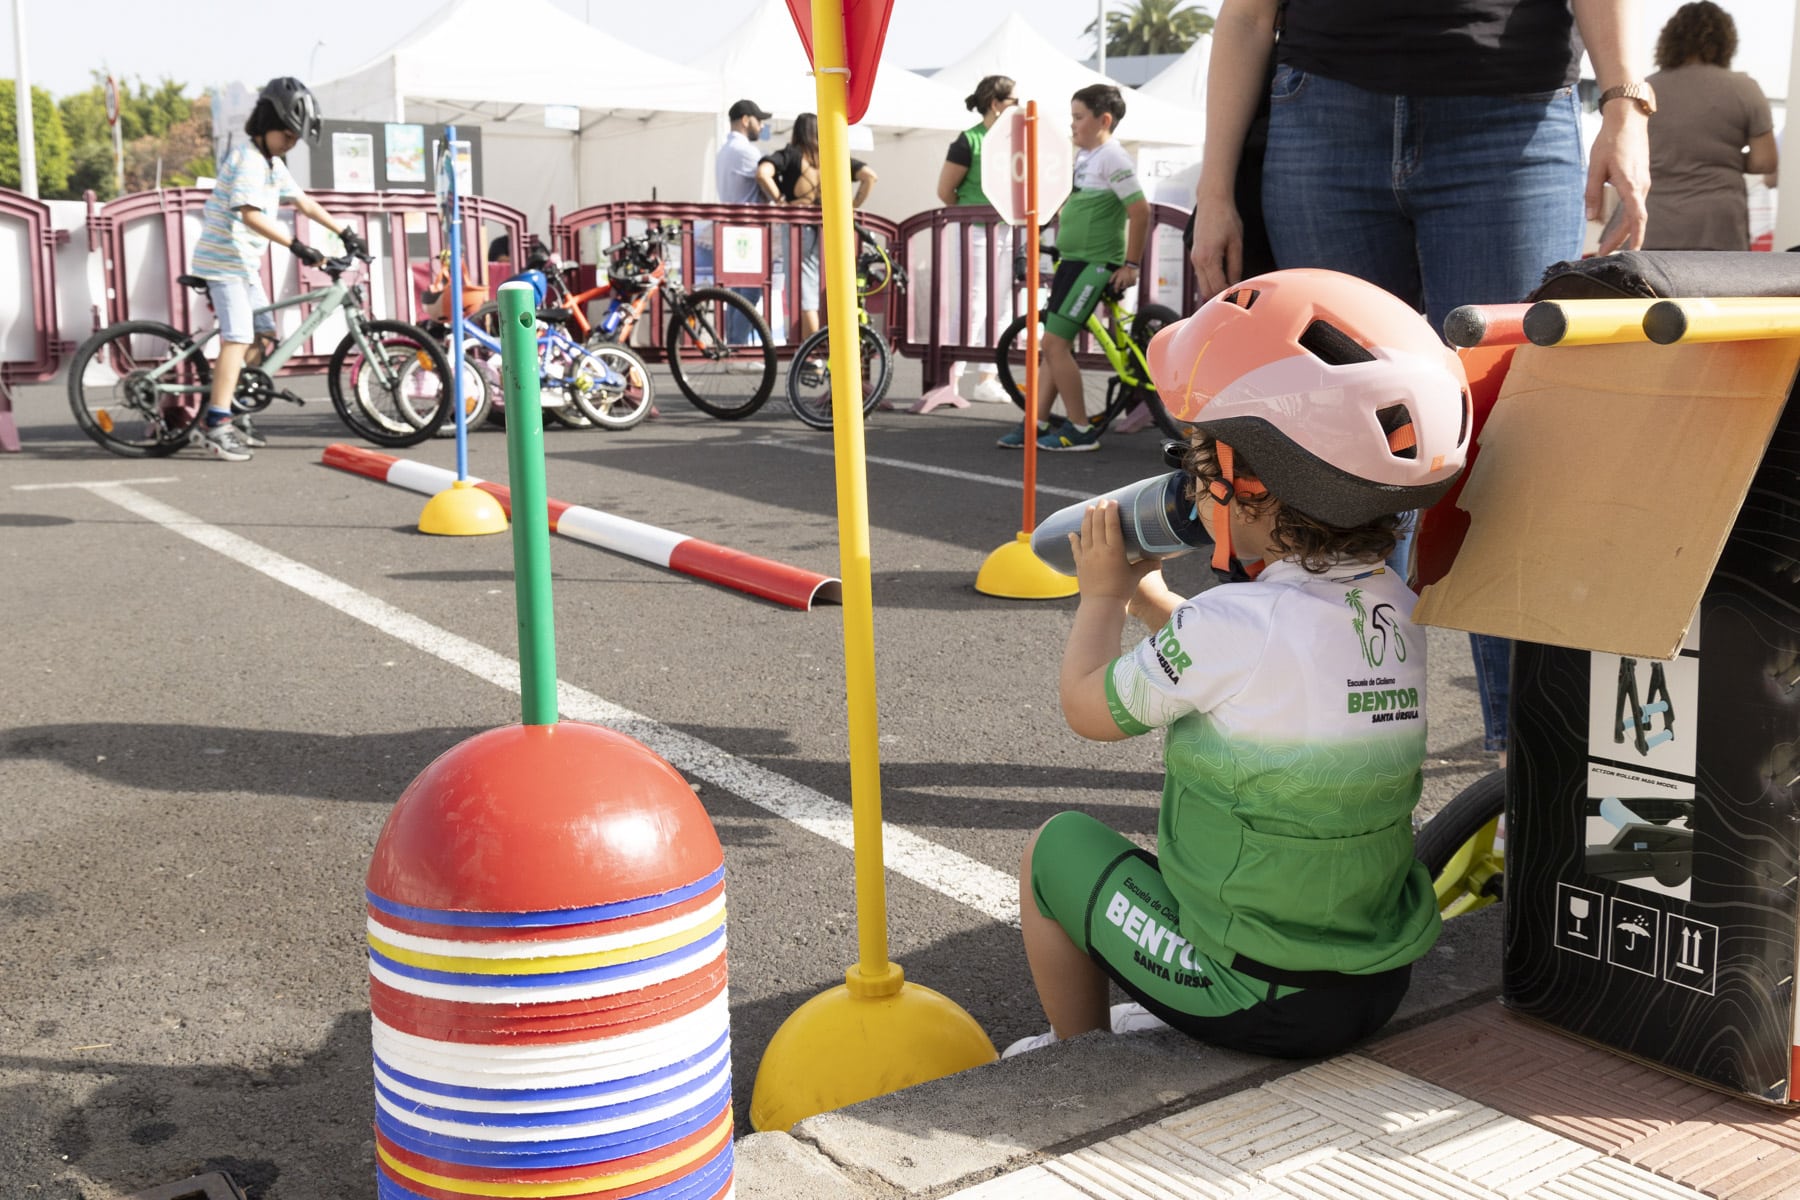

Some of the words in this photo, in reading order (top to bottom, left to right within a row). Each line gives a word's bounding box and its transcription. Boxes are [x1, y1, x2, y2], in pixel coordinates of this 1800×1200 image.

[1159, 621, 1193, 675] TOR
[1348, 688, 1419, 714] BENTOR
[1372, 713, 1394, 723] SANTA
[1395, 710, 1419, 721] ÚRSULA
[1591, 767, 1615, 776] ACTION
[1616, 772, 1641, 781] ROLLER
[1656, 781, 1678, 790] MODEL
[1123, 877, 1151, 903] Escuela
[1151, 899, 1162, 912] de
[1105, 890, 1203, 972] BENTO
[1133, 949, 1170, 981] SANTA
